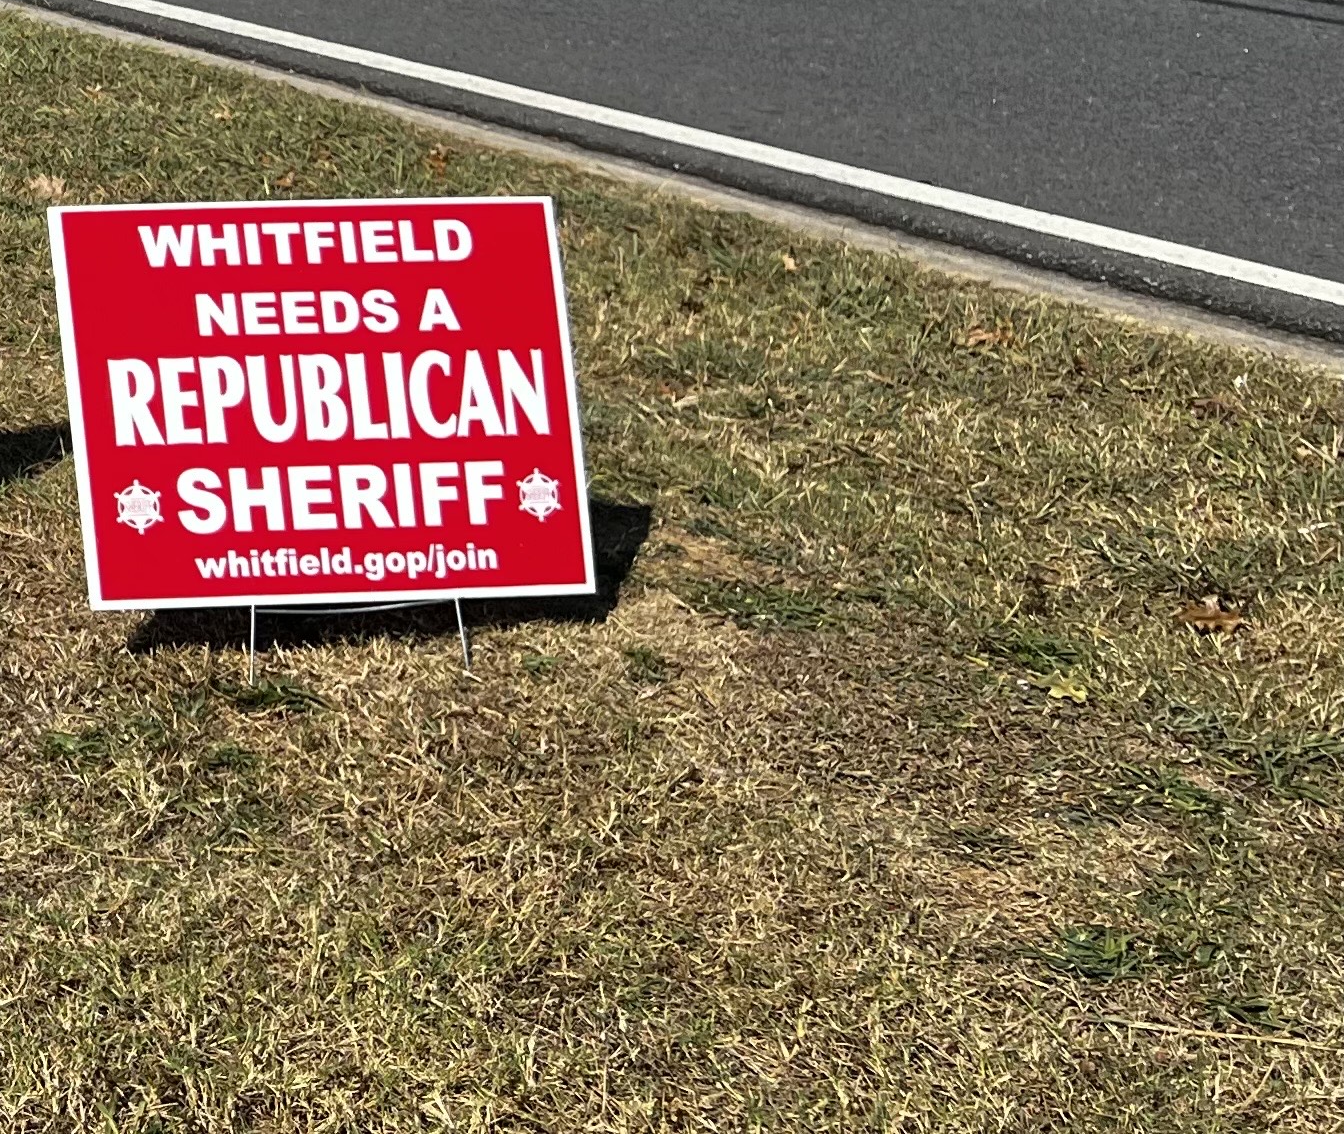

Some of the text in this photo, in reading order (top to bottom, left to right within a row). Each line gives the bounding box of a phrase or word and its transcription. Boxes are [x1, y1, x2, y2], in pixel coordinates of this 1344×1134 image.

[137, 219, 473, 268] WHITFIELD
[195, 288, 461, 337] NEEDS A
[107, 348, 551, 447] REPUBLICAN
[176, 460, 505, 535] SHERIFF
[194, 542, 498, 581] whitfield.gop/join
